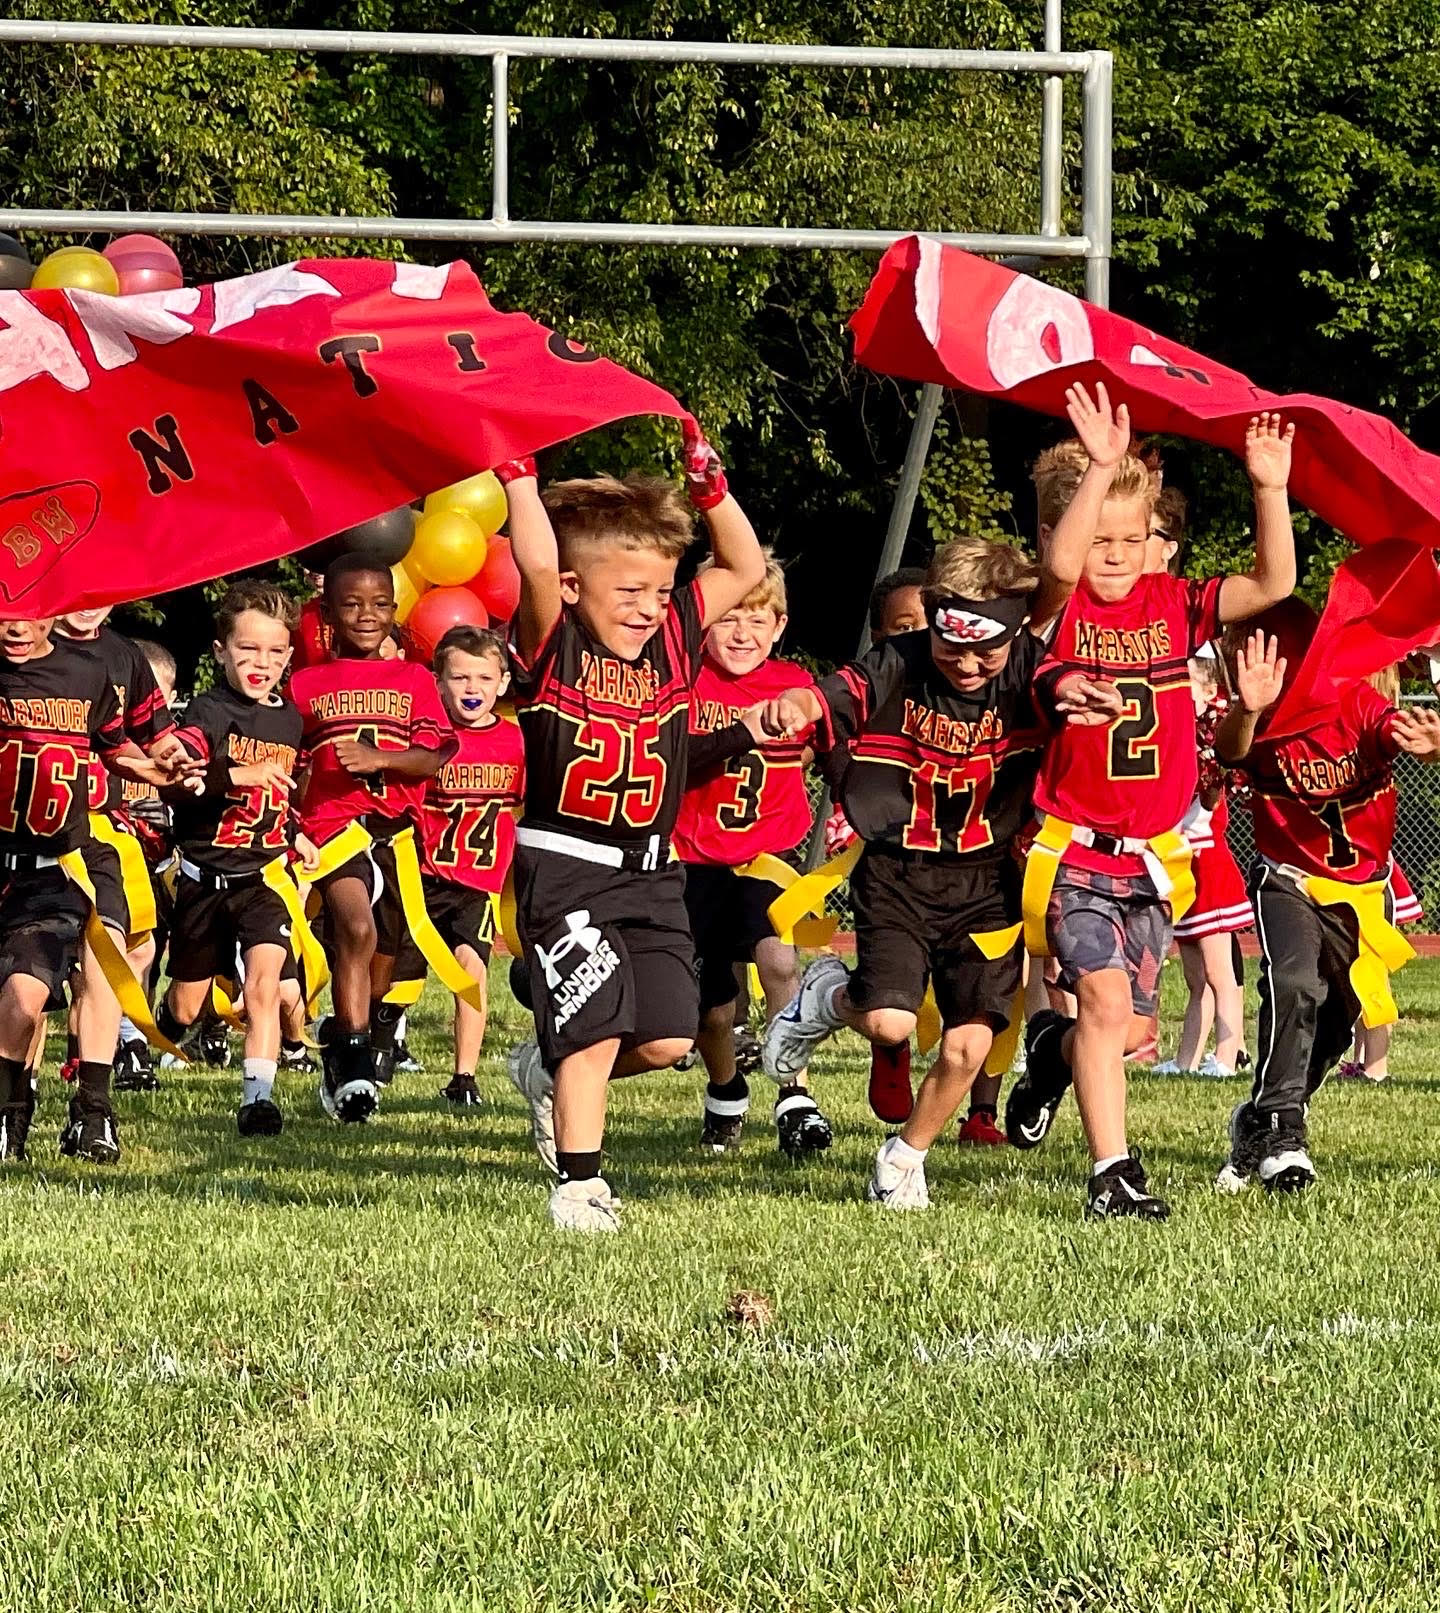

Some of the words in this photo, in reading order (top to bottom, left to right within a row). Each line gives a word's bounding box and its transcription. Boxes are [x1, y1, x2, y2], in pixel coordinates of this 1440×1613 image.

[1, 495, 77, 568] BW
[309, 689, 412, 721] WARRIORS
[1106, 677, 1159, 781] 2
[0, 740, 78, 837] 16
[557, 713, 667, 828] 25
[716, 749, 767, 832] 3
[903, 754, 996, 853] 17
[432, 799, 504, 870] 14
[1310, 798, 1359, 871] 1
[554, 940, 611, 1005] UNDER
[554, 951, 620, 1034] ARMOUR
